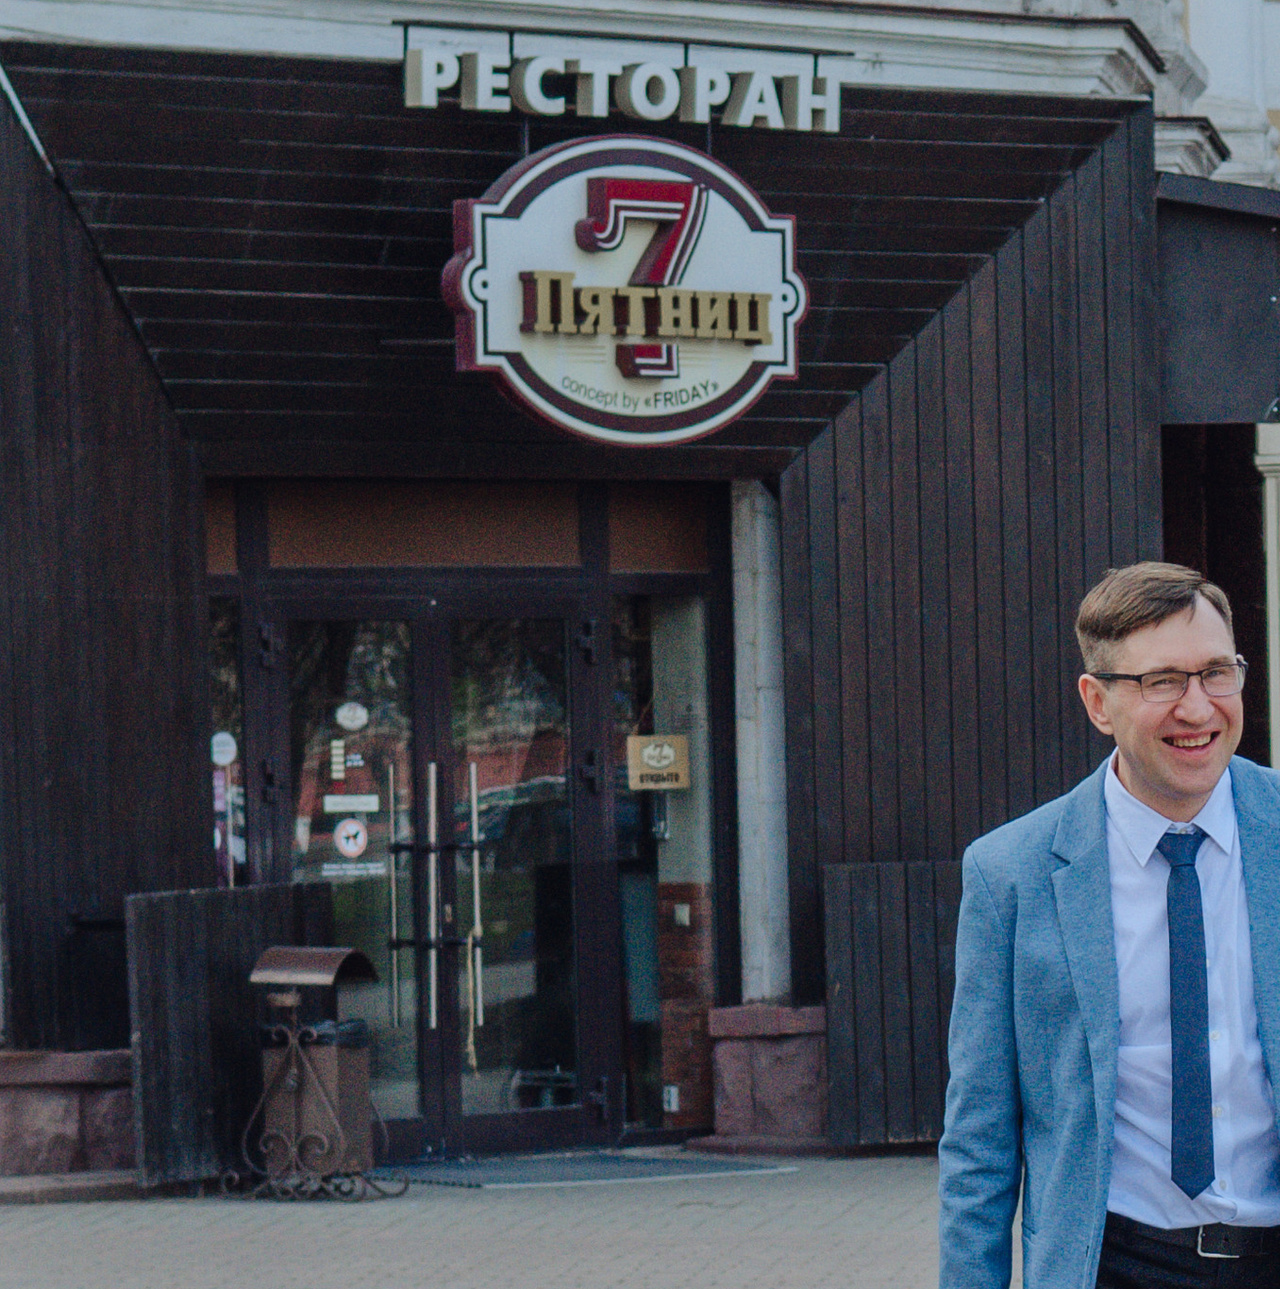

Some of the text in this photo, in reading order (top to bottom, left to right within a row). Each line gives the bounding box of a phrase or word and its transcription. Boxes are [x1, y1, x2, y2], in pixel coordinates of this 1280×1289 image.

[405, 49, 842, 133] РЕСТОРАН
[574, 177, 709, 378] 7
[561, 376, 618, 408] concept
[622, 392, 640, 413] by
